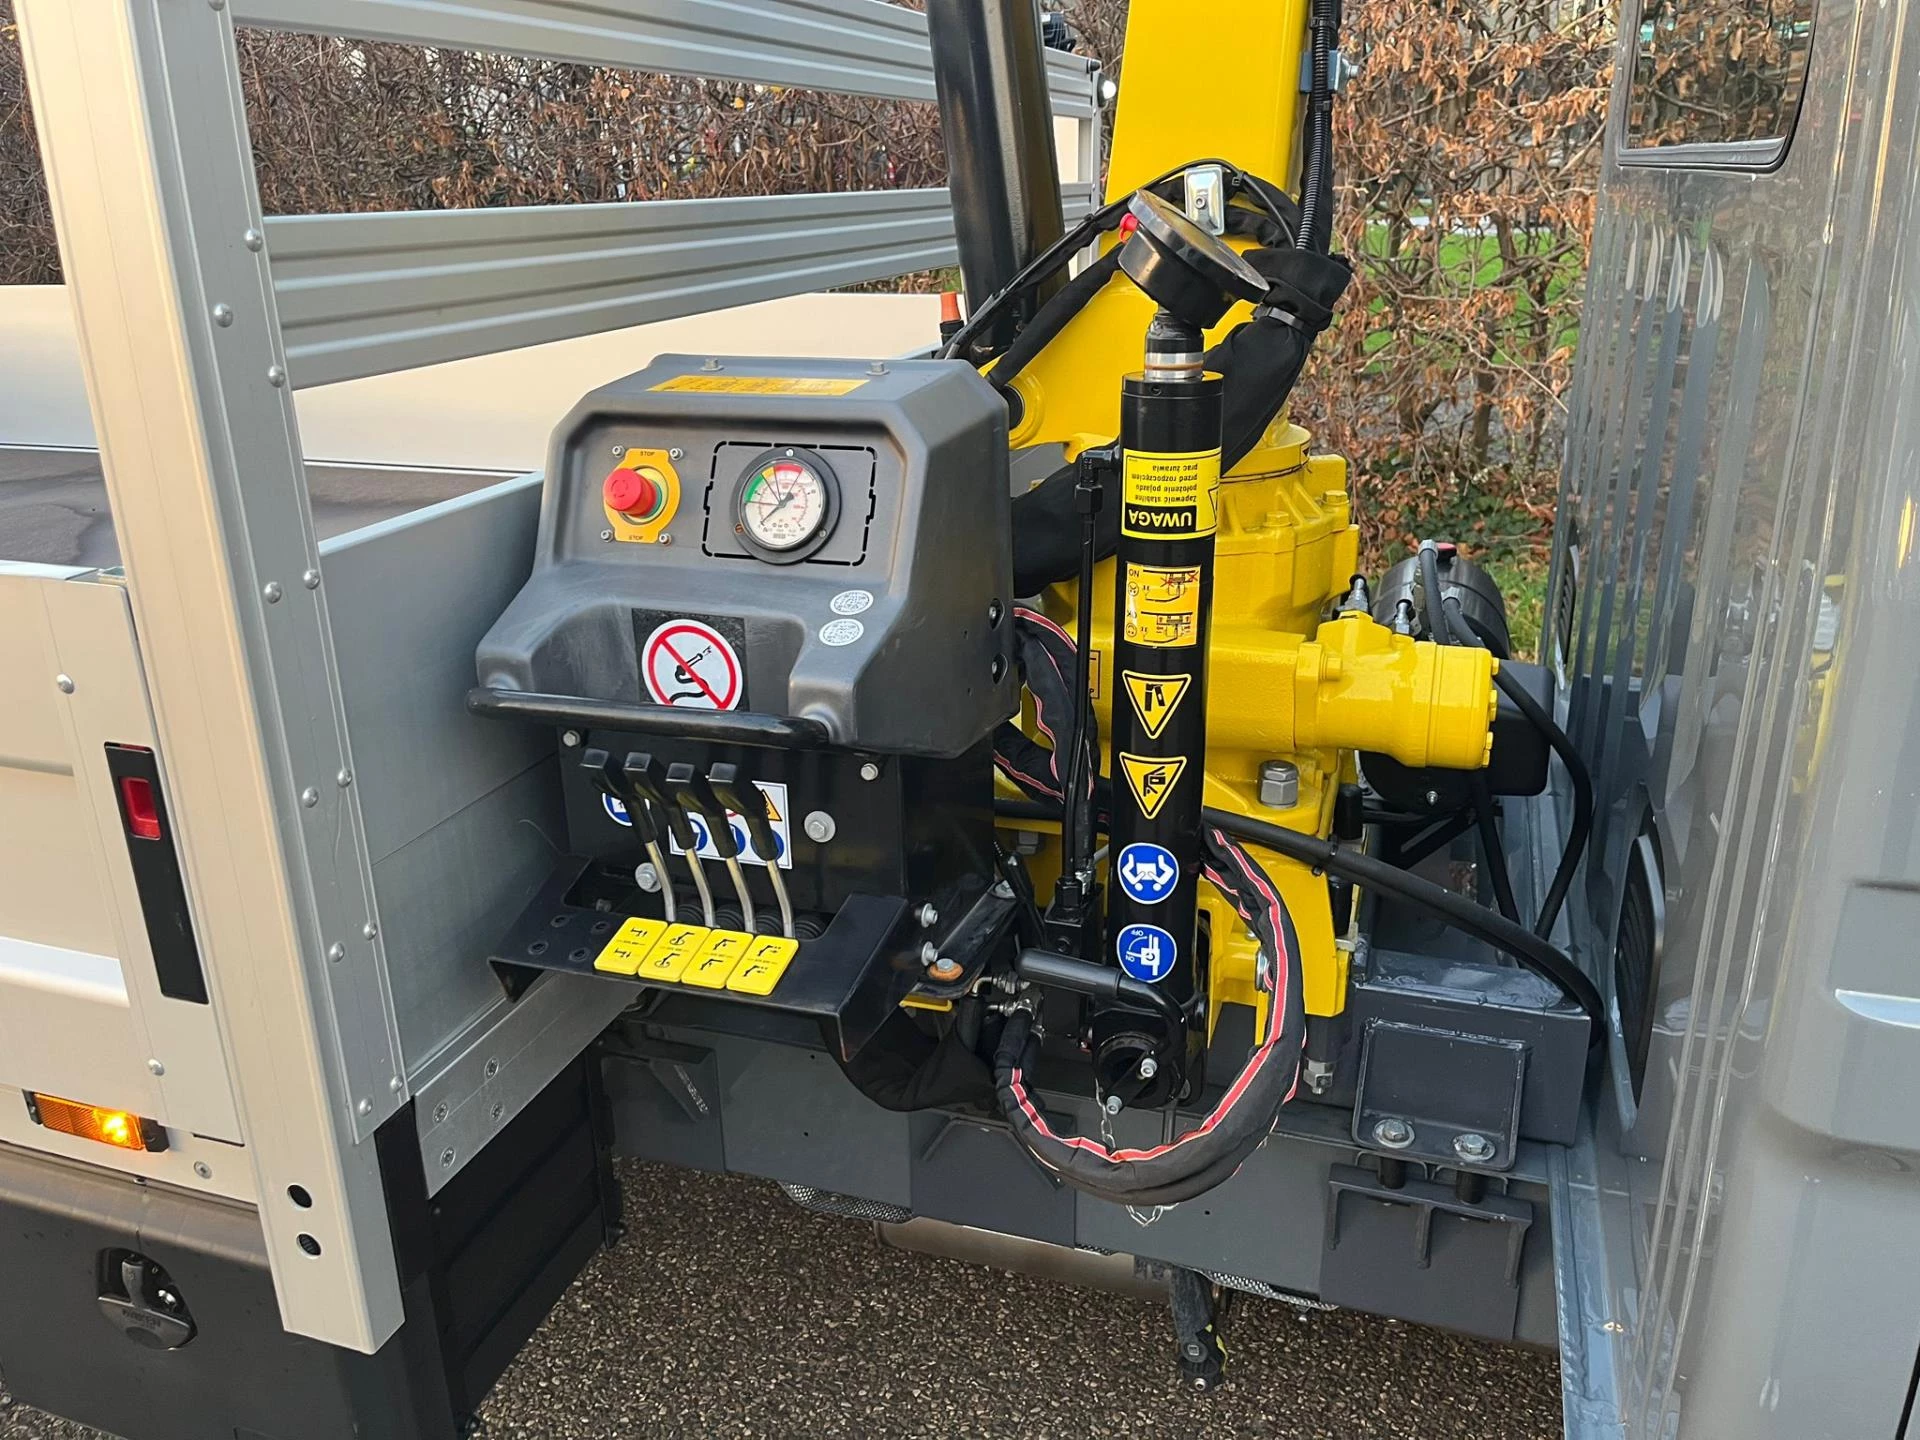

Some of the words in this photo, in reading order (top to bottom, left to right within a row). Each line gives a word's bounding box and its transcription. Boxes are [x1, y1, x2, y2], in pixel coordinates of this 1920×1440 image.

[1179, 474, 1198, 482] przed
[1136, 483, 1161, 492] pojazdu
[1135, 494, 1161, 503] stabilne
[1128, 509, 1192, 527] UWAGA
[1128, 568, 1139, 577] NO
